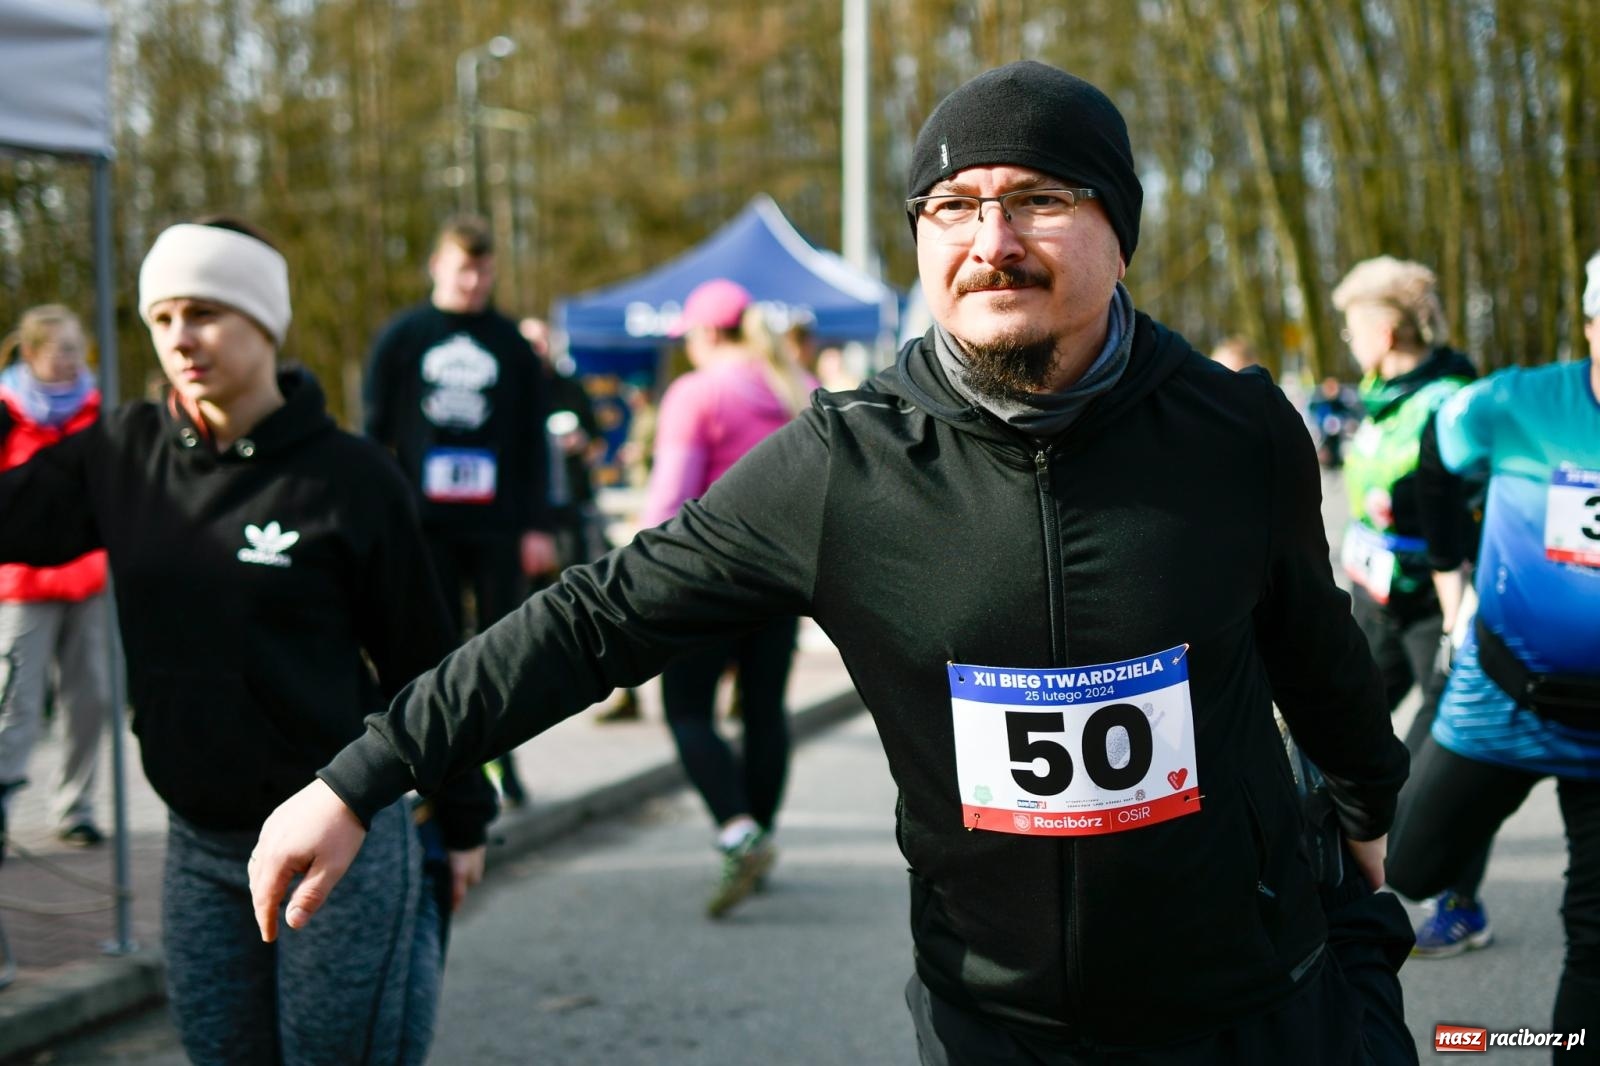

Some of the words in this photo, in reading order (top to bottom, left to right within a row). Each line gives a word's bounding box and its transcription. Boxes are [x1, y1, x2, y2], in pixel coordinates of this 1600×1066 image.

[973, 671, 997, 687] XII
[1000, 673, 1041, 689] BIEG
[1044, 658, 1164, 689] TWARDZIELA
[1025, 691, 1040, 701] 25
[1042, 690, 1082, 703] lutego
[1085, 685, 1115, 699] 2024
[1005, 703, 1153, 796] 50
[1034, 814, 1103, 829] Racibórz
[1118, 805, 1151, 823] OSiR
